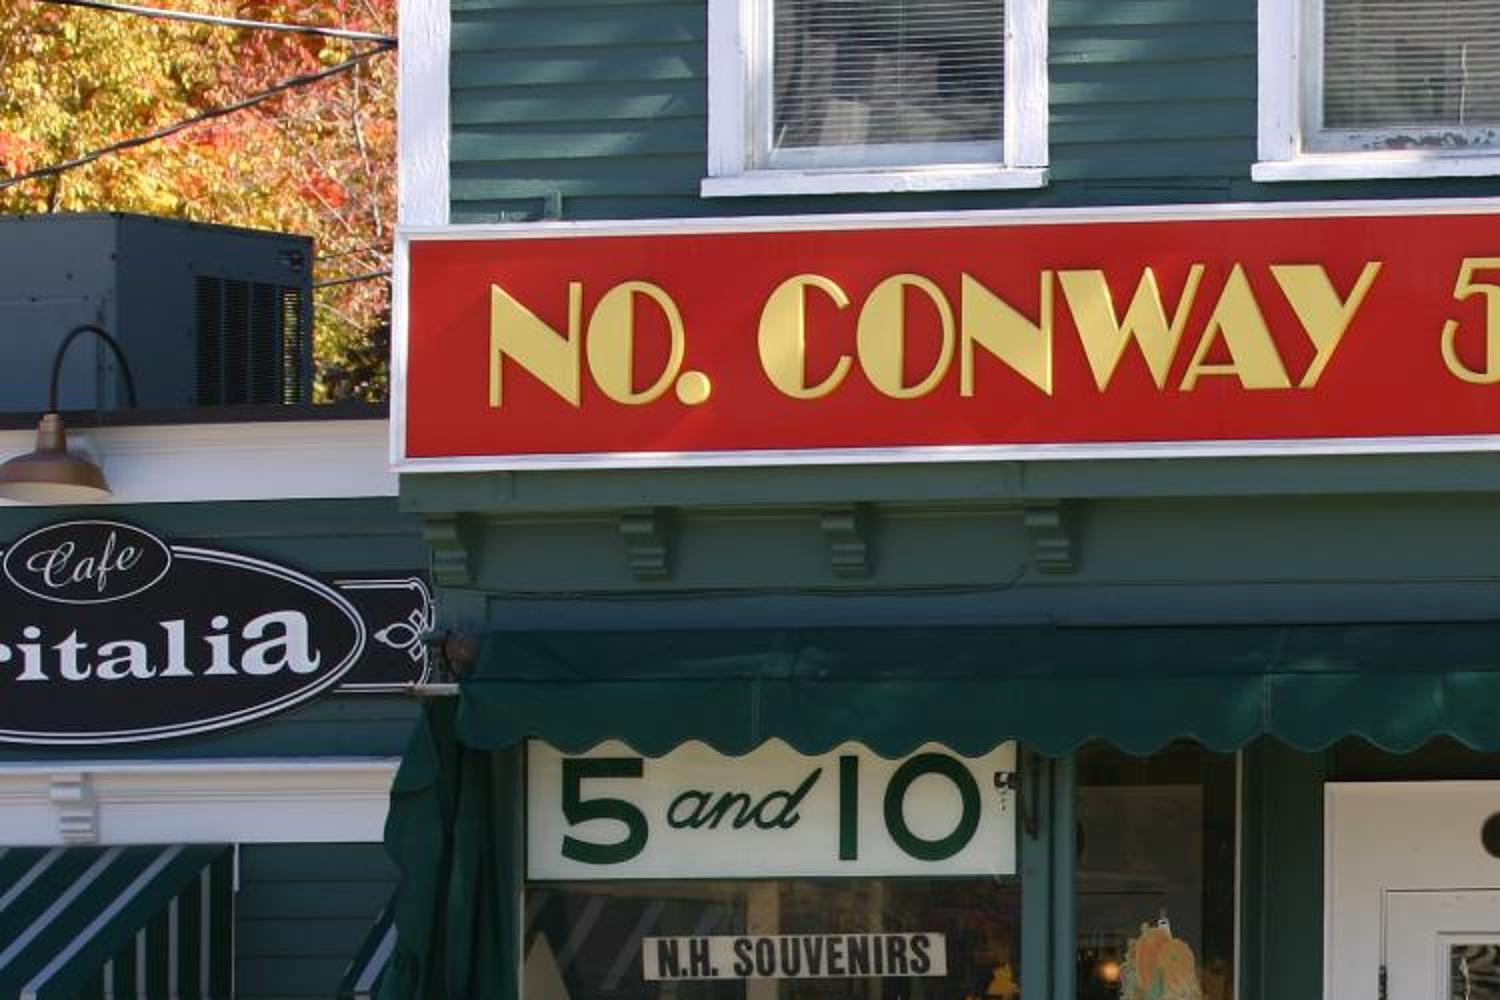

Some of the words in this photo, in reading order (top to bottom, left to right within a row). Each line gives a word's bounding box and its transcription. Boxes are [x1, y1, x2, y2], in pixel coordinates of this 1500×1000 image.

[489, 281, 712, 408] NO.
[757, 260, 1383, 400] CONWAY
[26, 530, 145, 592] Cafe
[561, 757, 650, 865] 5
[666, 767, 823, 831] and
[838, 752, 982, 862] 10
[733, 934, 931, 977] SOUVENIRS
